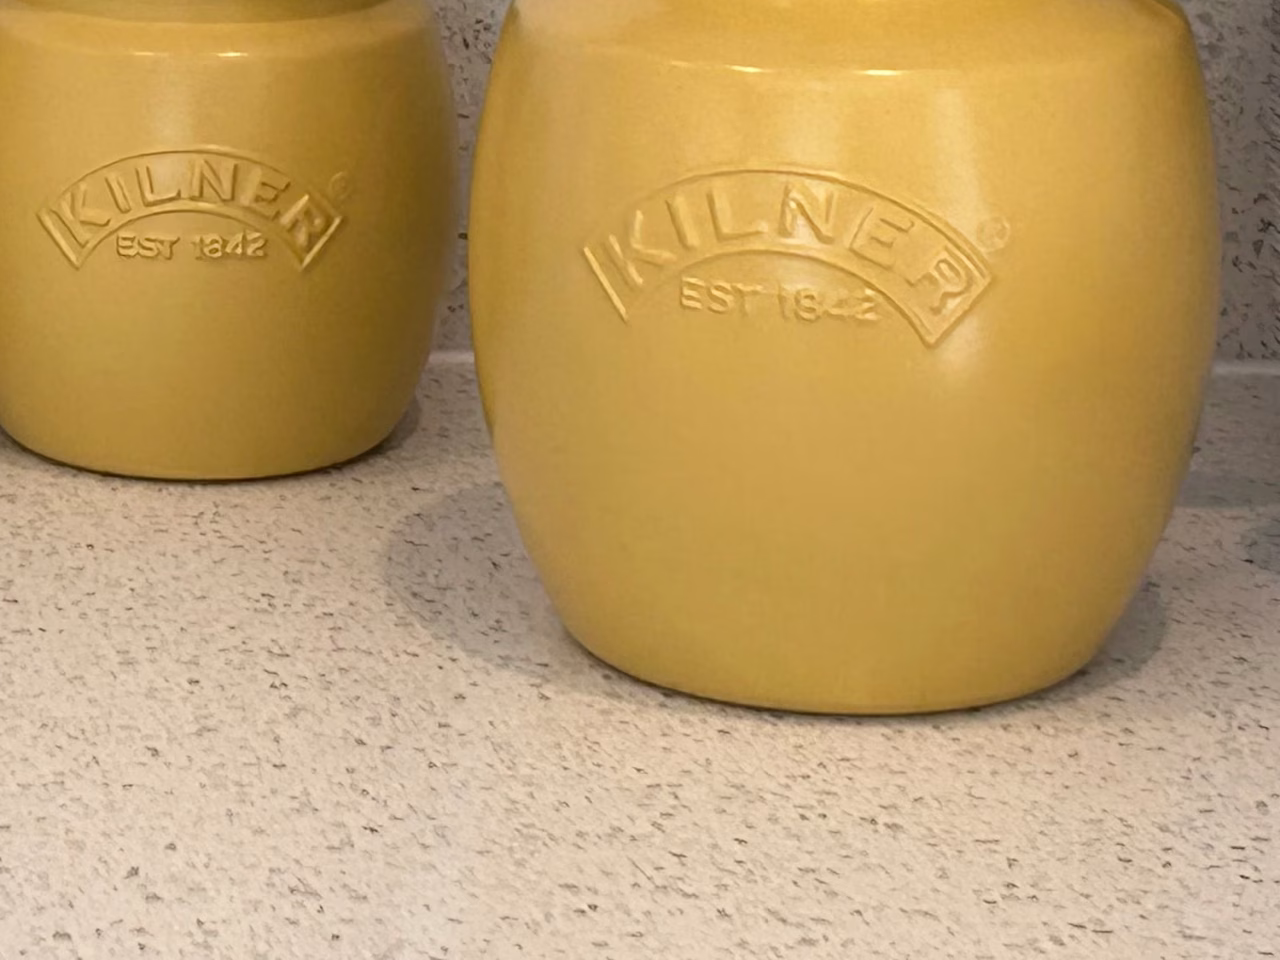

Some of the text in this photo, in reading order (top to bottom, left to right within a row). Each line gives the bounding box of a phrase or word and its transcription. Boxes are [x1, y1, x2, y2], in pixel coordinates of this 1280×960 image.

[51, 158, 326, 248] KILNER
[116, 232, 268, 260] EST 1842
[609, 182, 975, 315] KILNER
[679, 276, 882, 323] EST 1842
